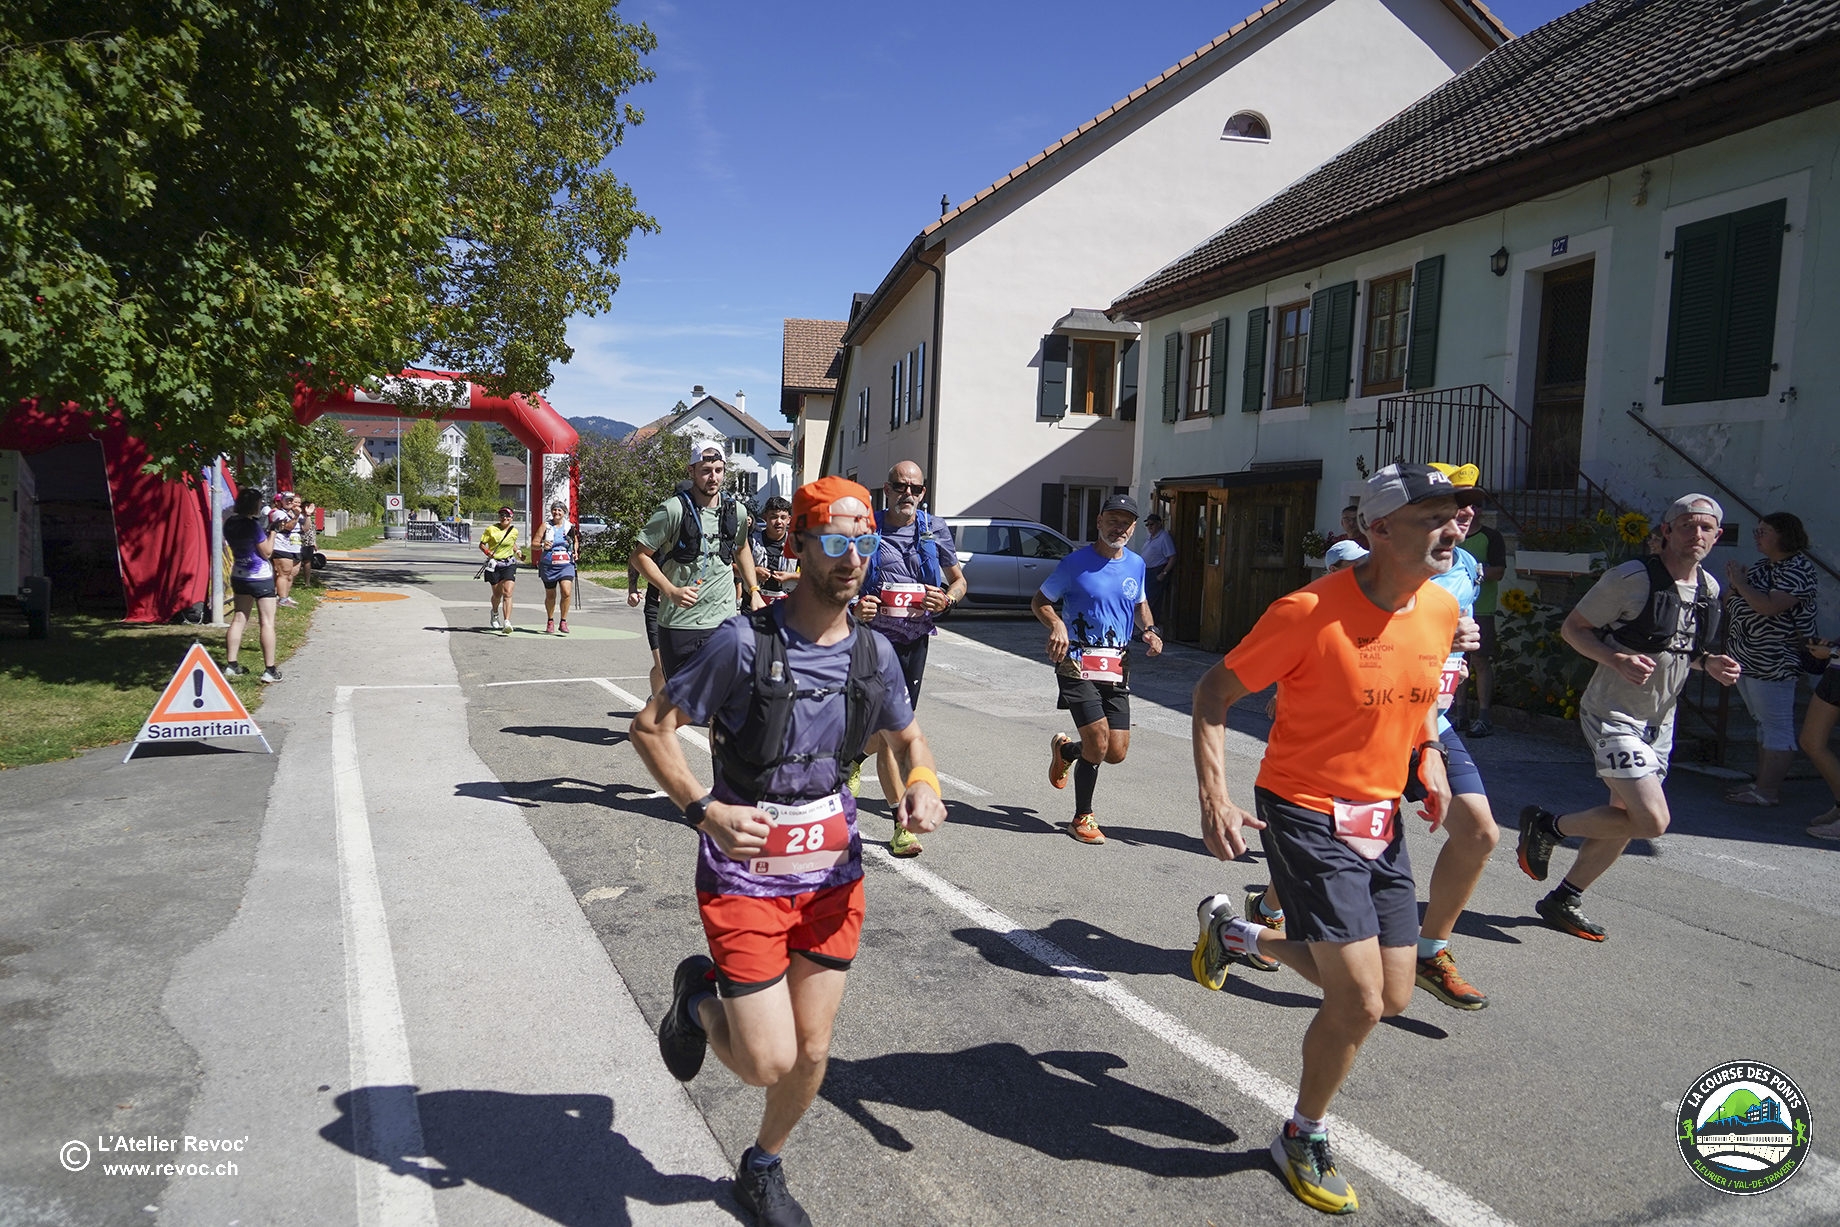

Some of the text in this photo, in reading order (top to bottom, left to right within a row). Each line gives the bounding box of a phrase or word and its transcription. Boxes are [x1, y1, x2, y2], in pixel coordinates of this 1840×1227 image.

[1553, 239, 1566, 253] 27
[894, 593, 913, 607] 62
[1099, 658, 1109, 671] 3
[1363, 688, 1394, 706] 31K
[1409, 687, 1438, 704] 51K
[147, 721, 250, 739] Samaritain
[1606, 751, 1647, 770] 125
[1370, 810, 1385, 837] 5
[785, 823, 825, 854] 28
[792, 861, 814, 871] Yann
